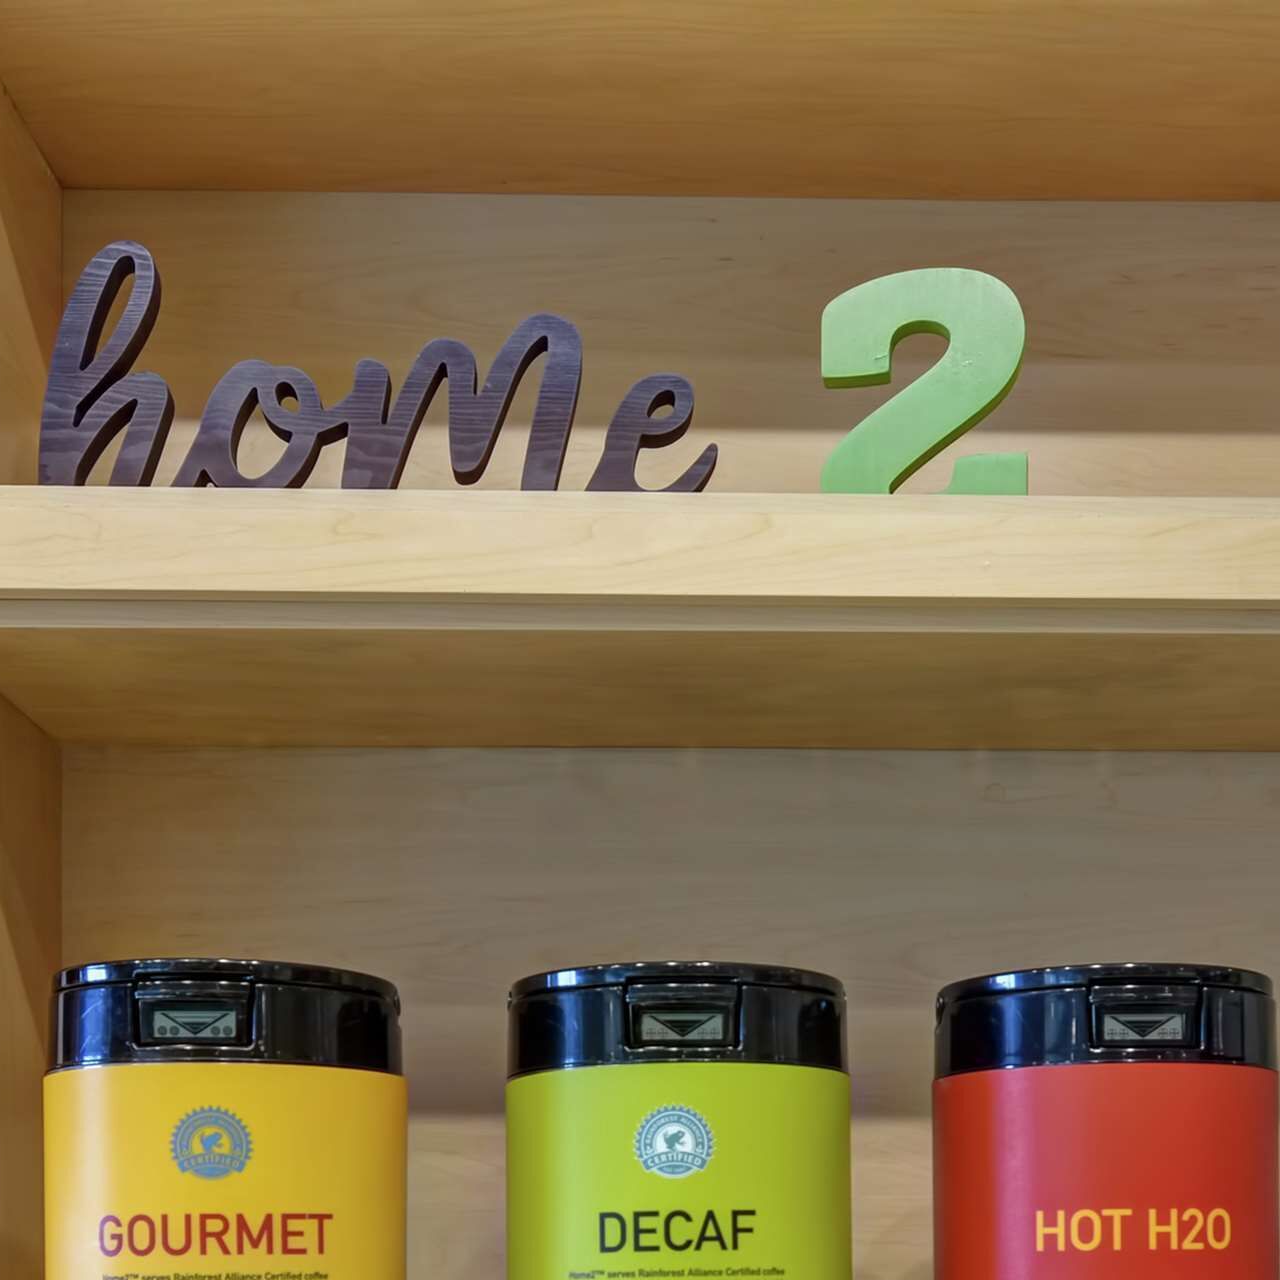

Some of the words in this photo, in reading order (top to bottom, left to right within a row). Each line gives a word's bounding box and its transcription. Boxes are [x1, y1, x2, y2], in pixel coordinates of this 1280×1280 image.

[39, 239, 718, 491] home
[821, 268, 1028, 494] 2
[647, 1153, 702, 1167] CERTIFIED
[99, 1213, 333, 1256] GOURMET
[599, 1210, 757, 1253] DECAF
[1035, 1209, 1132, 1252] HOT
[225, 1272, 262, 1280] Alliance
[264, 1272, 302, 1280] Certified
[304, 1271, 329, 1280] coffee
[638, 1269, 685, 1278] Rainforest
[688, 1268, 723, 1277] Alliance
[726, 1267, 761, 1276] Certified
[763, 1267, 785, 1275] coffee
